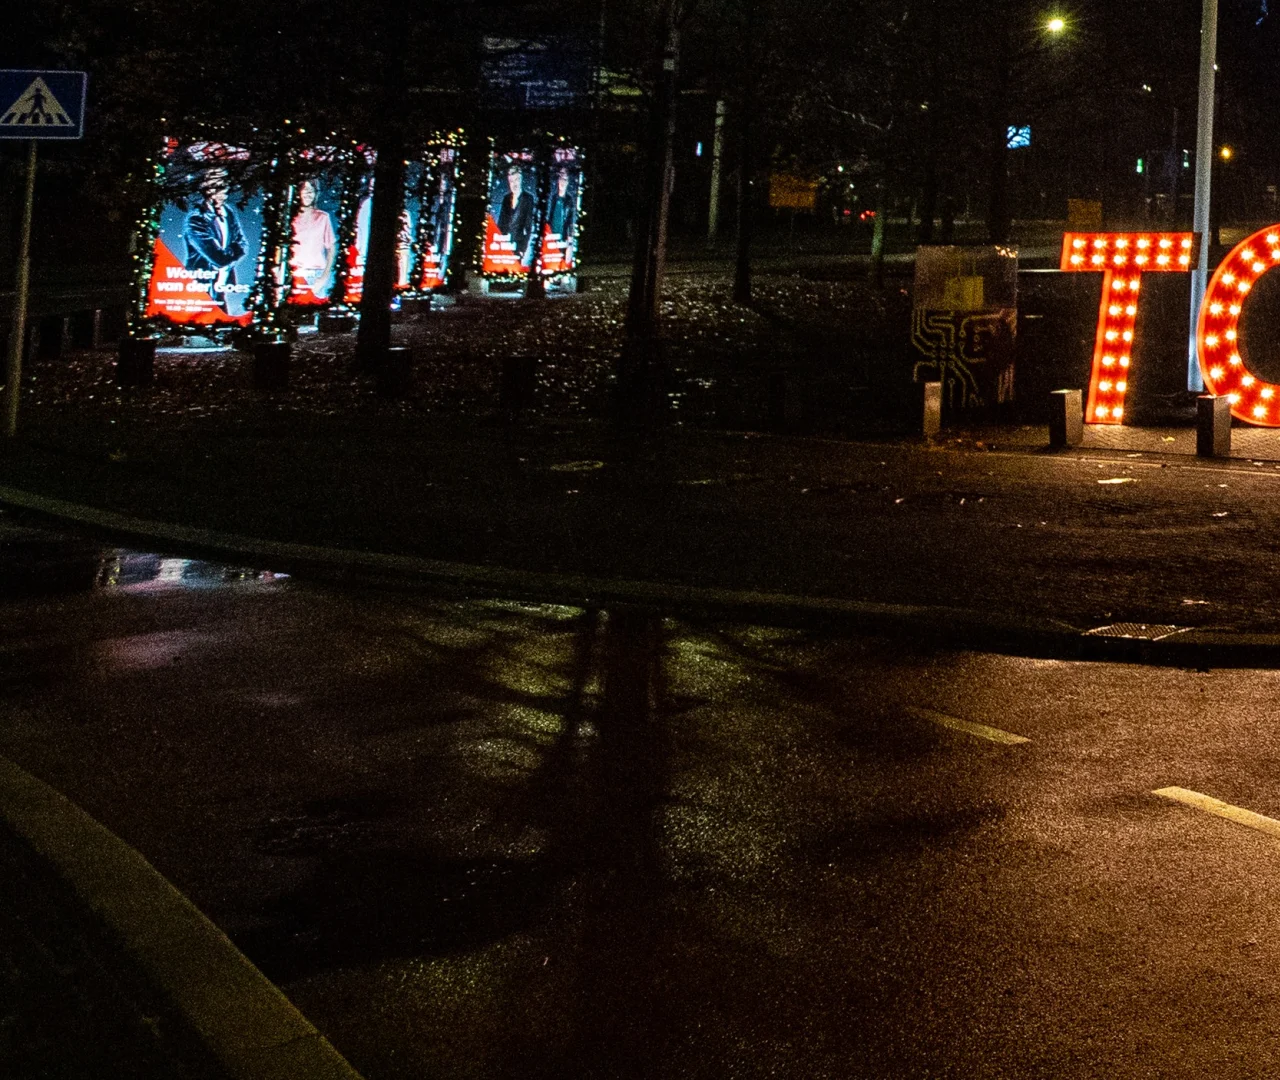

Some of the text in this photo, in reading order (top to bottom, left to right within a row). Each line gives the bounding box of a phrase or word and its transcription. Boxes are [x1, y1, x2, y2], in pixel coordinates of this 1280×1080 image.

[166, 267, 217, 279] Wouter
[157, 282, 183, 291] van
[186, 280, 210, 292] der
